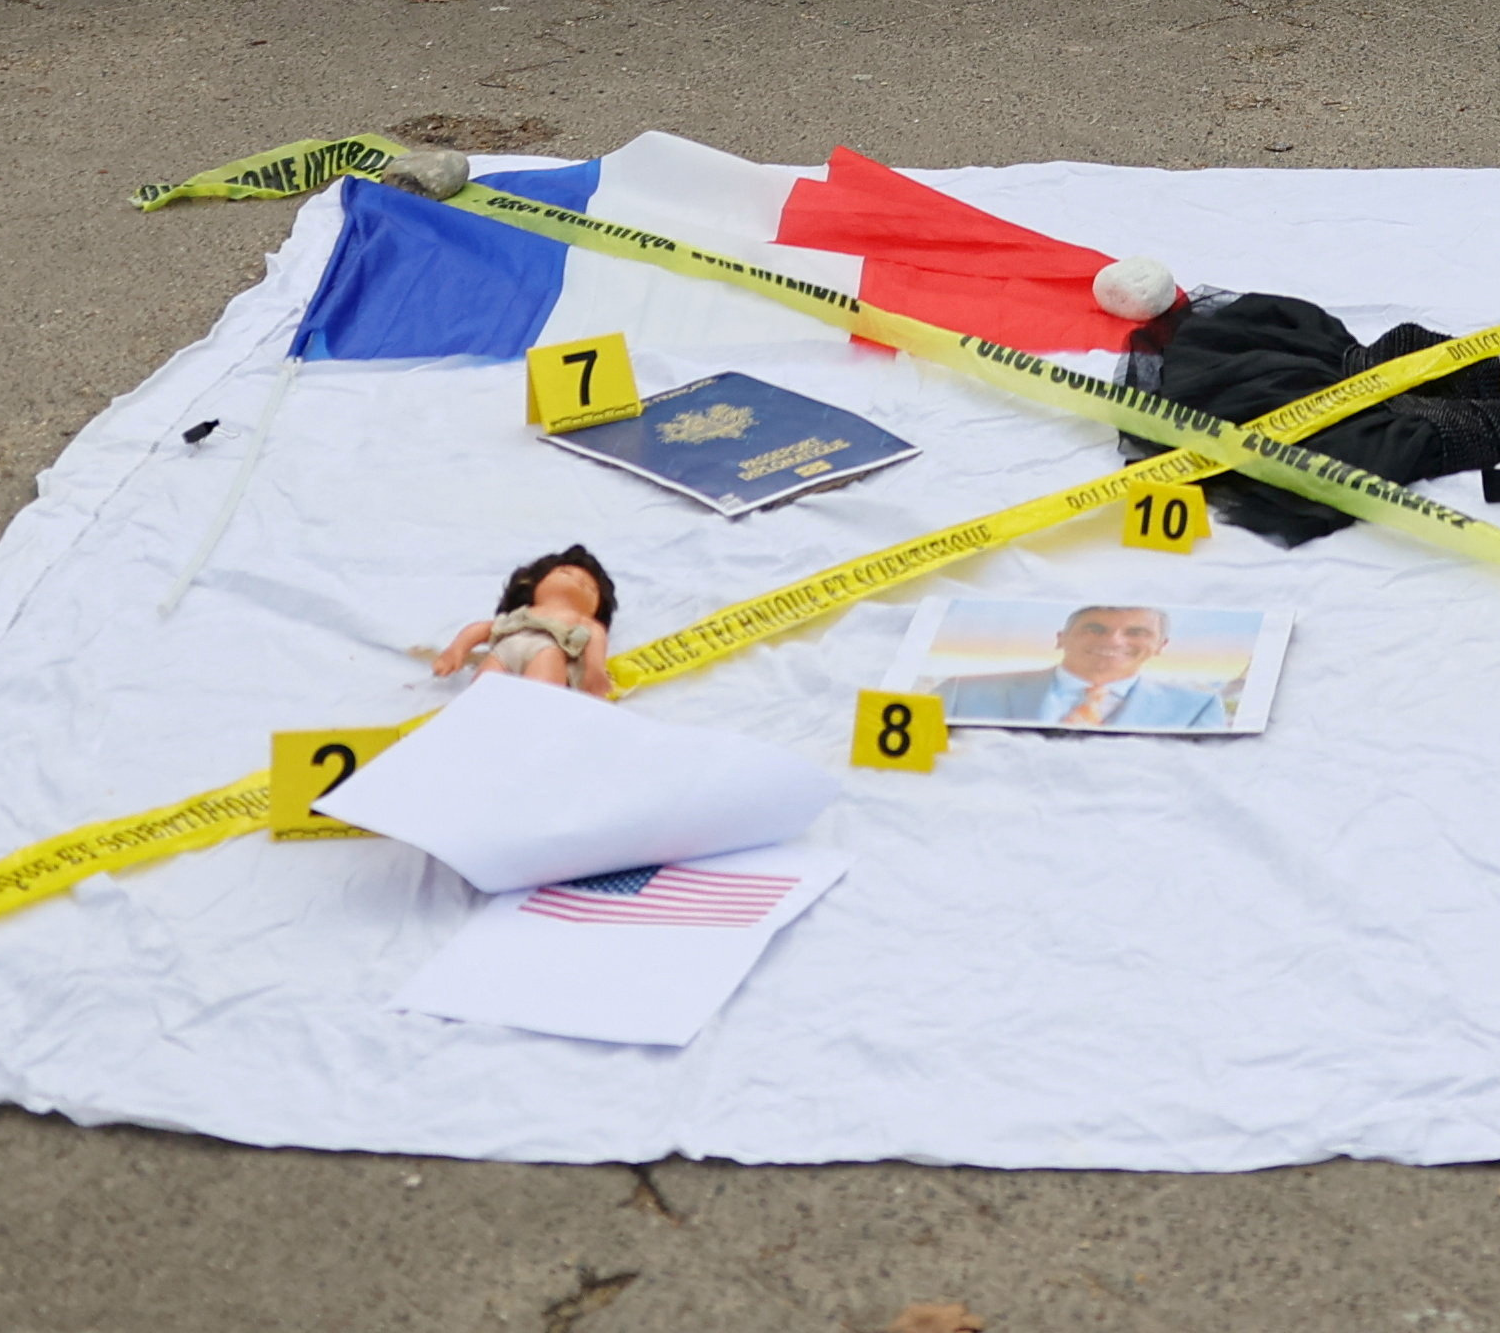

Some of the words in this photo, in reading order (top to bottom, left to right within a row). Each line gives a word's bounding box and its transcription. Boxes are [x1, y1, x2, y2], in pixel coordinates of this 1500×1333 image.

[562, 350, 597, 406] 7
[1134, 495, 1188, 539] 10
[690, 583, 825, 655] TECHNIQUE
[878, 703, 912, 758] 8
[310, 743, 357, 816] 2
